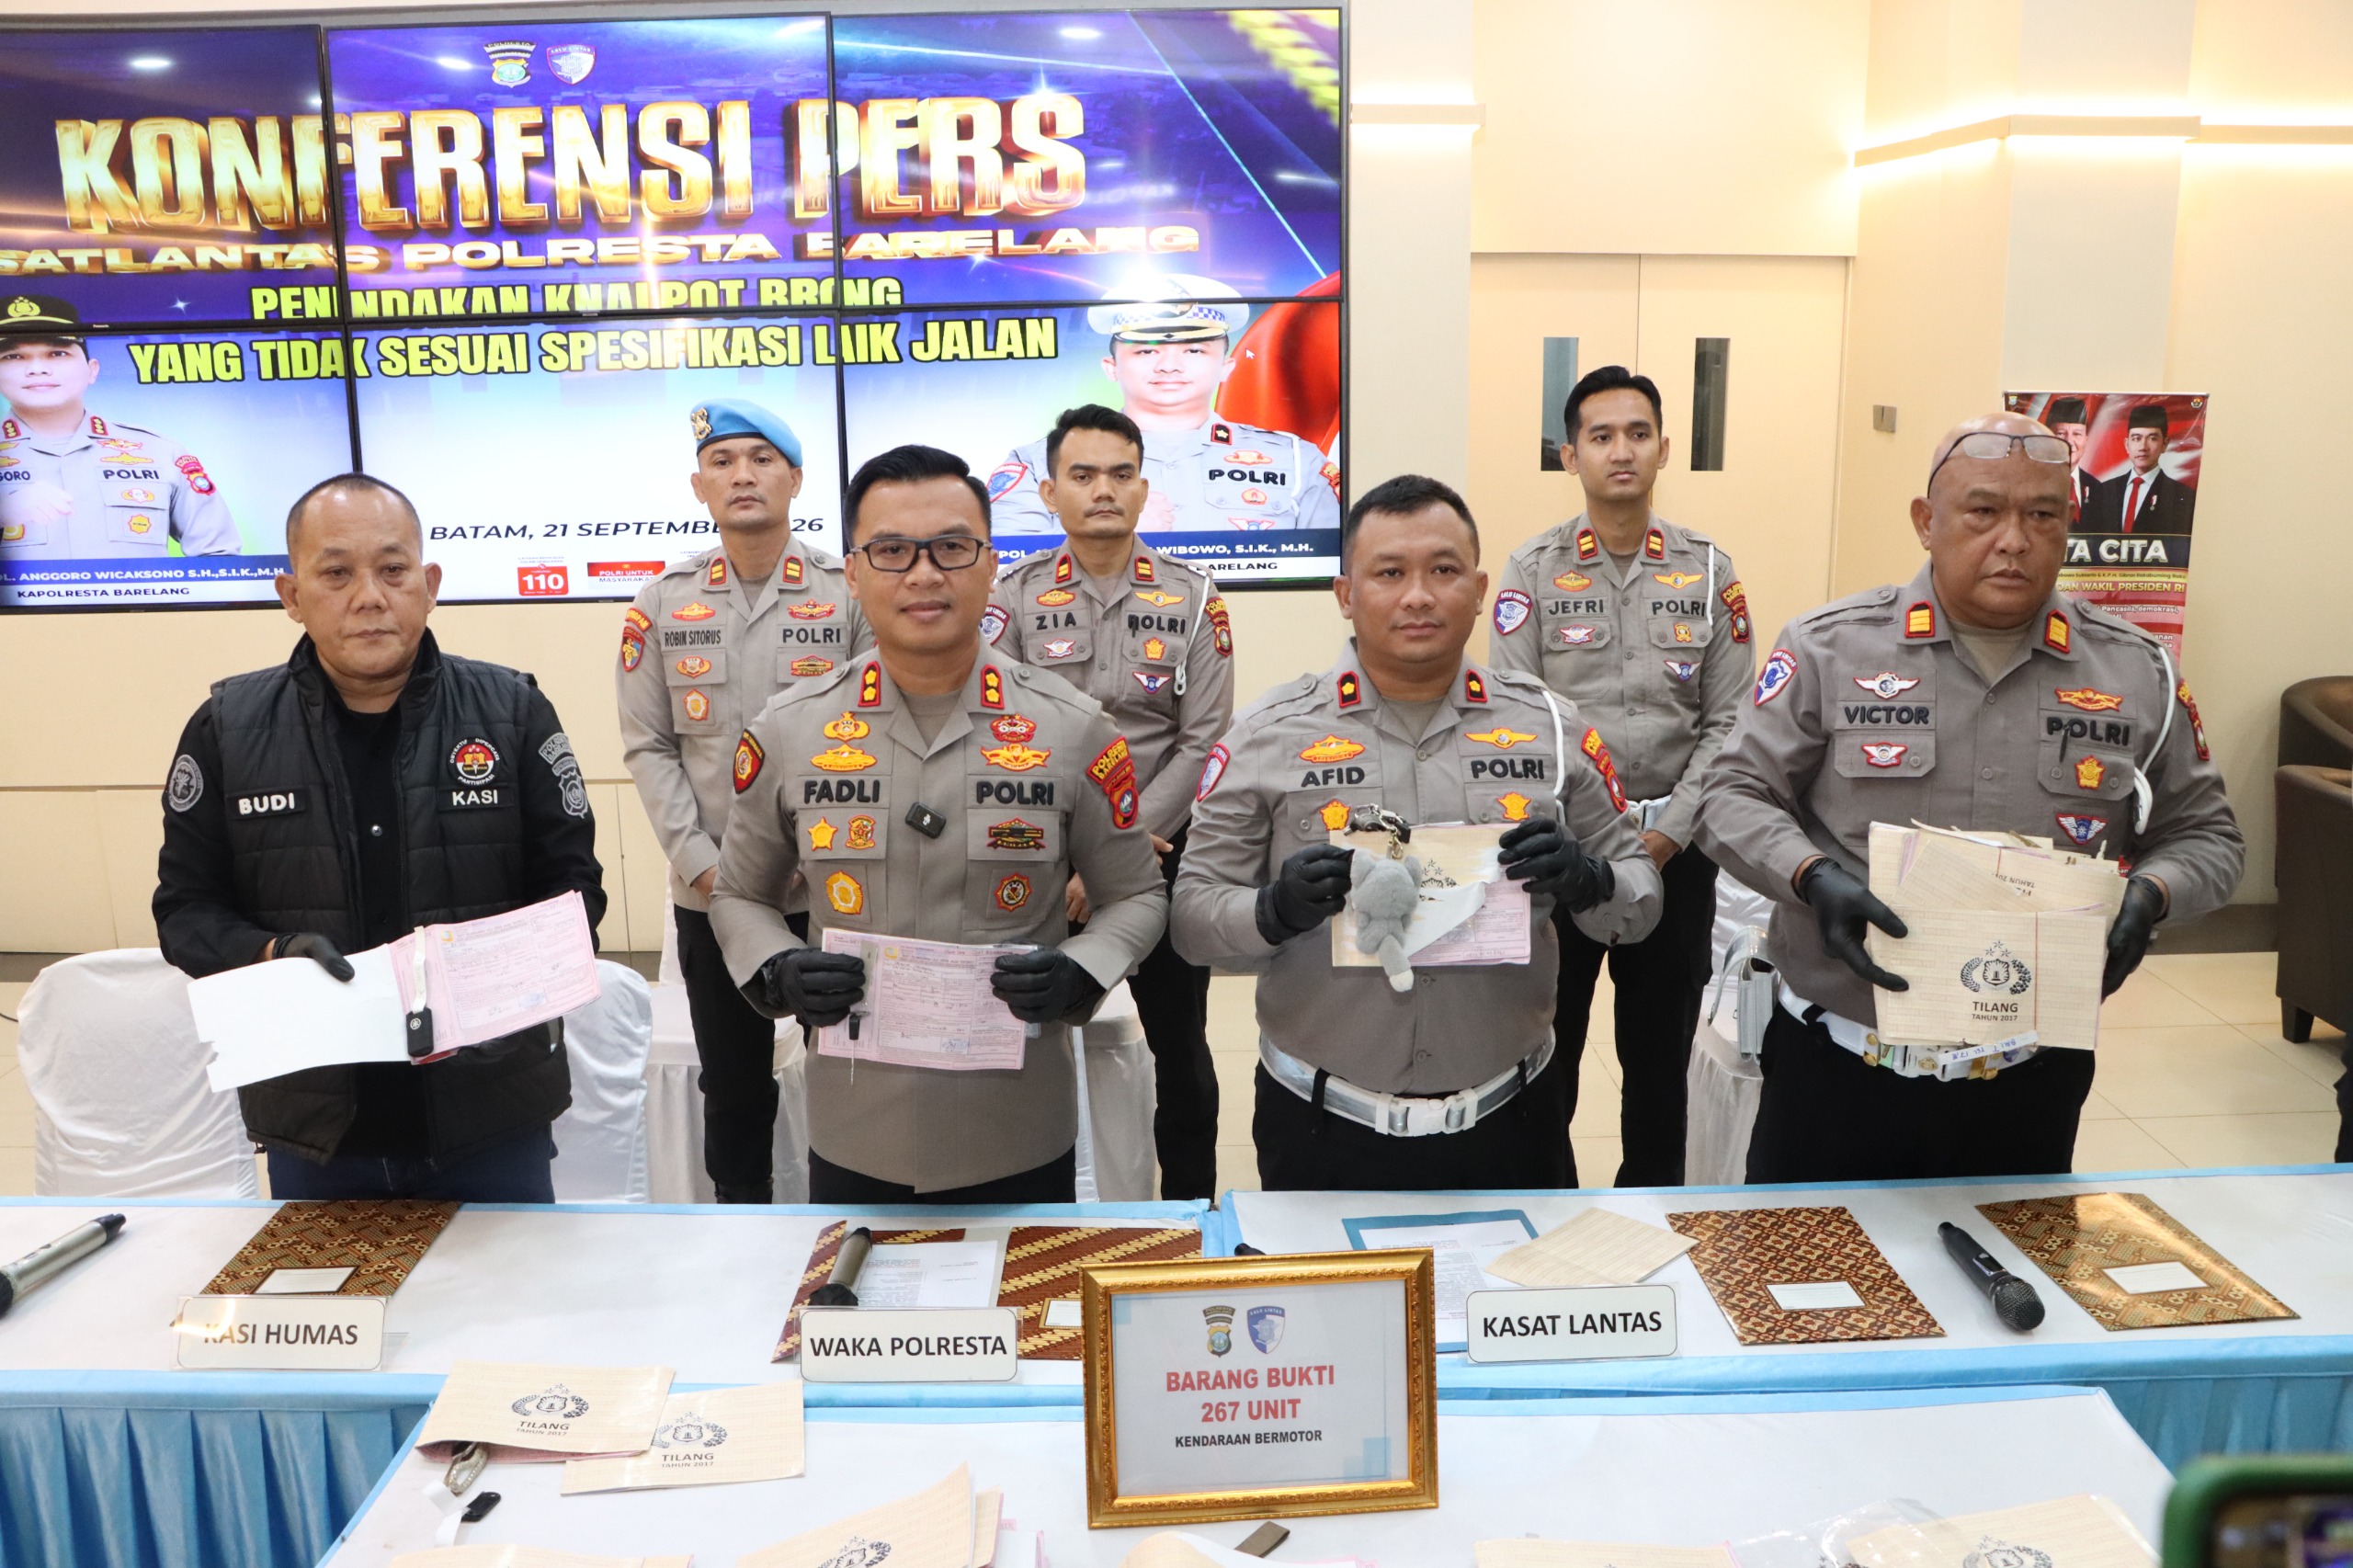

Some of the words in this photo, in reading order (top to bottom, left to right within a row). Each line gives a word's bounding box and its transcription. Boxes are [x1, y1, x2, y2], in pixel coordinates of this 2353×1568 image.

[56, 100, 753, 233] KONFERENSI
[794, 94, 1086, 219] PERS
[403, 233, 782, 270] POLRESTA
[129, 340, 243, 384] YANG
[378, 332, 530, 377] SESUAI
[539, 324, 802, 373] SPESIFIKASI
[910, 316, 1058, 362] JALAN
[103, 469, 160, 480] POLRI
[1209, 468, 1286, 485] POLRI
[430, 525, 534, 540] BATAM,
[542, 524, 568, 538] 21
[577, 520, 721, 538] SEPTEMB
[790, 517, 824, 532] 26
[1156, 544, 1232, 555] WIBOWO,
[1281, 542, 1314, 552] M.H.
[2098, 539, 2169, 563] CITA
[19, 571, 92, 582] ANGGORO
[95, 569, 184, 581] WICAKSONO
[1198, 562, 1279, 571] ARELANG
[17, 589, 108, 598] KAPOLRESTA
[114, 586, 190, 597] BARELANG
[522, 574, 564, 590] 110
[2081, 582, 2116, 591] WAKIL
[2118, 582, 2171, 592] PRESIDEN
[2174, 584, 2186, 593] RI
[1548, 598, 1605, 616] JEFRI
[1652, 599, 1708, 617] POLRI
[1036, 611, 1077, 631] ZIA
[665, 631, 688, 647] ROBIN
[688, 629, 722, 645] SITORUS
[782, 627, 841, 643] POLRI
[1844, 705, 1930, 725] VICTOR
[2046, 716, 2131, 746] POLRI
[1301, 766, 1366, 788] AFID
[1471, 757, 1545, 780] POLRI
[451, 789, 498, 806] KASI
[804, 778, 881, 804] FADLI
[976, 780, 1054, 806] POLRI
[238, 792, 295, 815] BUDI
[1972, 1001, 2018, 1013] TILANG
[1972, 1013, 1998, 1021] TAHUN
[2000, 1014, 2018, 1022] 2017
[1483, 1314, 1562, 1339] KASAT
[1568, 1310, 1663, 1336] LANTAS
[202, 1324, 258, 1346] KASI
[265, 1324, 358, 1346] HUMAS
[810, 1335, 883, 1358] WAKA
[891, 1335, 1008, 1358] POLRESTA
[1165, 1367, 1259, 1393] BARANG
[1267, 1364, 1336, 1389] BUKTI
[1200, 1400, 1241, 1423] 267
[1247, 1398, 1302, 1421] UNIT
[516, 1427, 545, 1436] TAHUN
[547, 1428, 568, 1437] 2017
[519, 1420, 570, 1431] TILANG
[1175, 1433, 1252, 1449] KENDARAAN
[1254, 1429, 1324, 1446] BERMOTOR
[661, 1452, 715, 1462] TILANG
